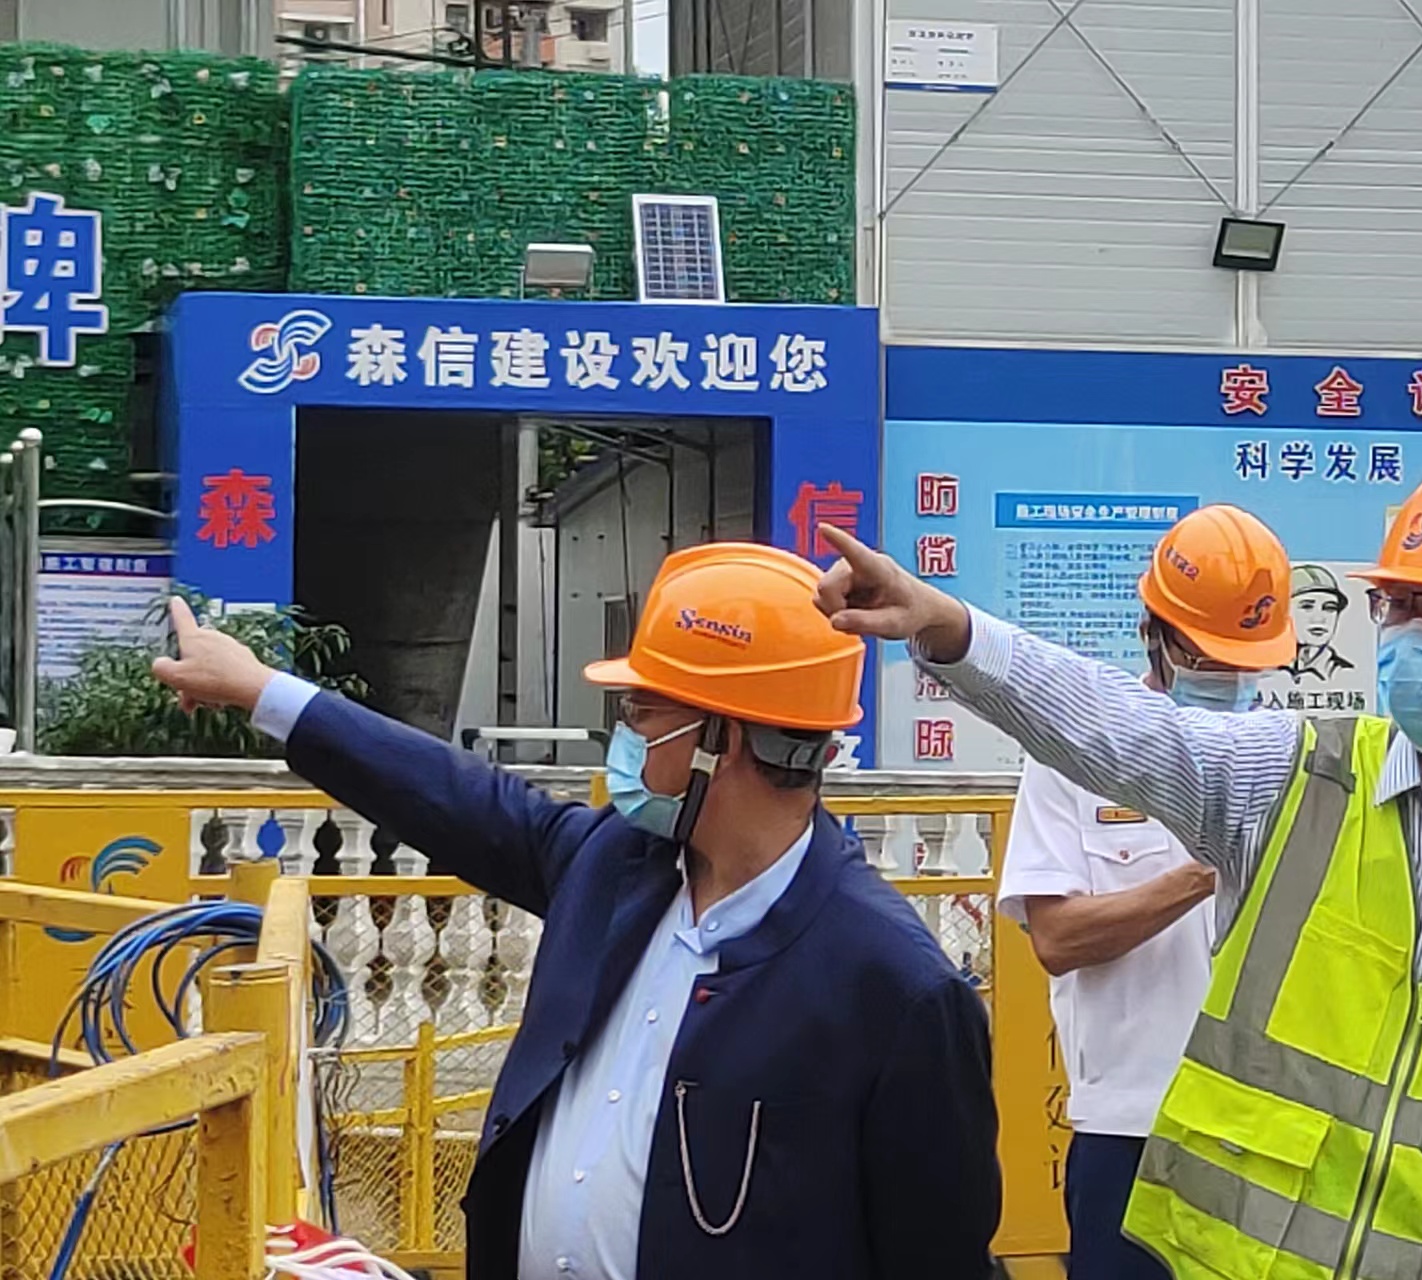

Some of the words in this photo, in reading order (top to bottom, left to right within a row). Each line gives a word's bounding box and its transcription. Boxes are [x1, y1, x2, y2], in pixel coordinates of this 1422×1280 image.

[346, 324, 828, 392] 森信建设欢迎您
[1235, 441, 1402, 482] 科学发展
[196, 468, 277, 548] 森
